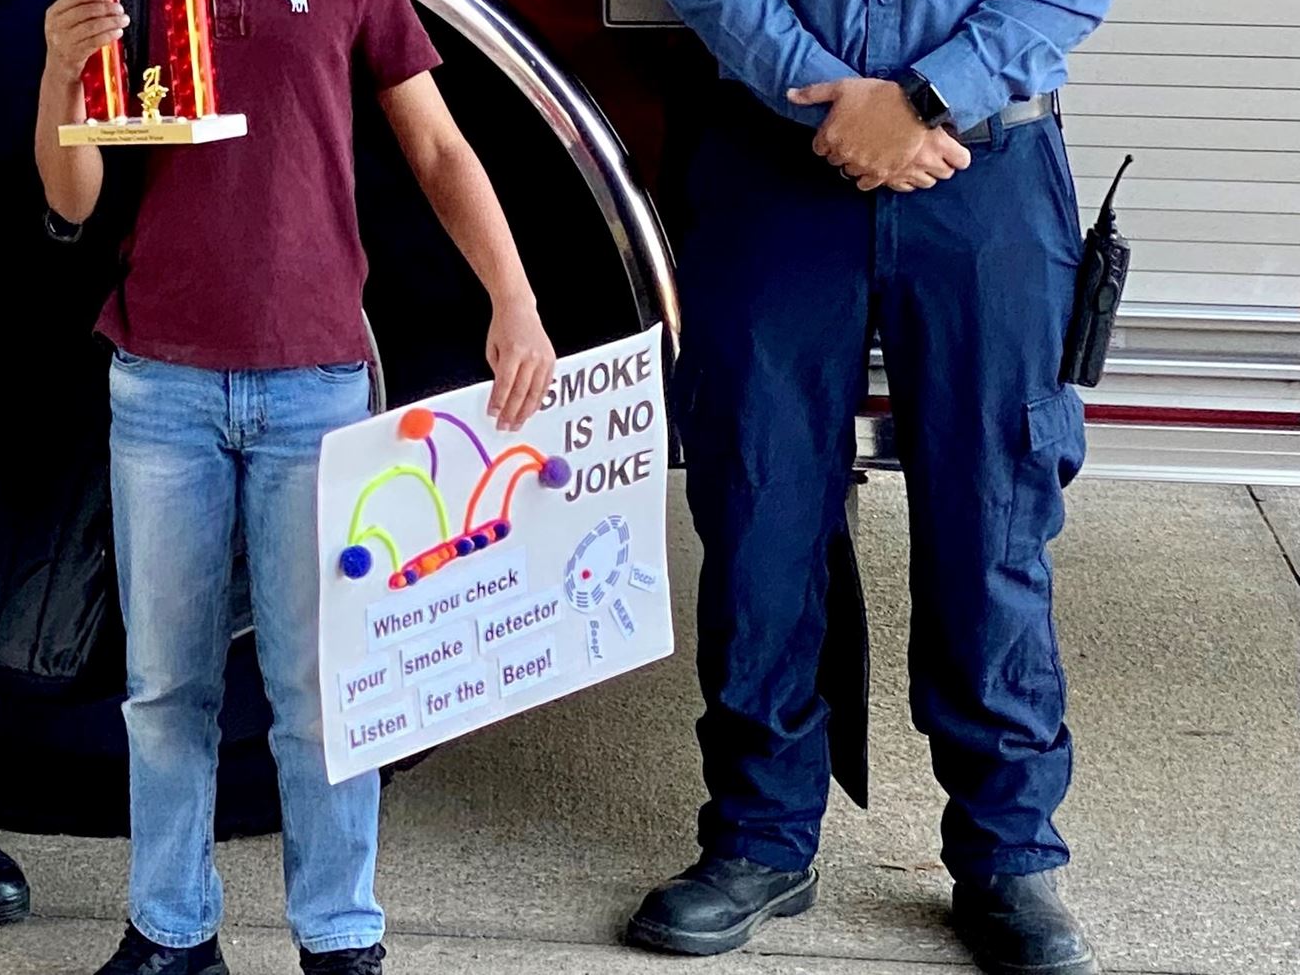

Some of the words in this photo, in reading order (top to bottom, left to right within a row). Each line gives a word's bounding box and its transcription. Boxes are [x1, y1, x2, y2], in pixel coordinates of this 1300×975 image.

[539, 346, 651, 411] SMOKE
[564, 415, 593, 453] IS
[607, 400, 654, 441] NO
[564, 449, 654, 502] JOKE
[373, 608, 424, 639] When
[428, 593, 461, 624] you
[465, 568, 519, 603] check
[346, 667, 388, 704] your
[404, 639, 463, 676] smoke
[484, 600, 559, 643] detector
[589, 620, 603, 659] Beep!
[350, 713, 408, 750] Listen
[426, 693, 452, 716] for
[456, 679, 485, 704] the
[502, 648, 553, 686] Beep!
